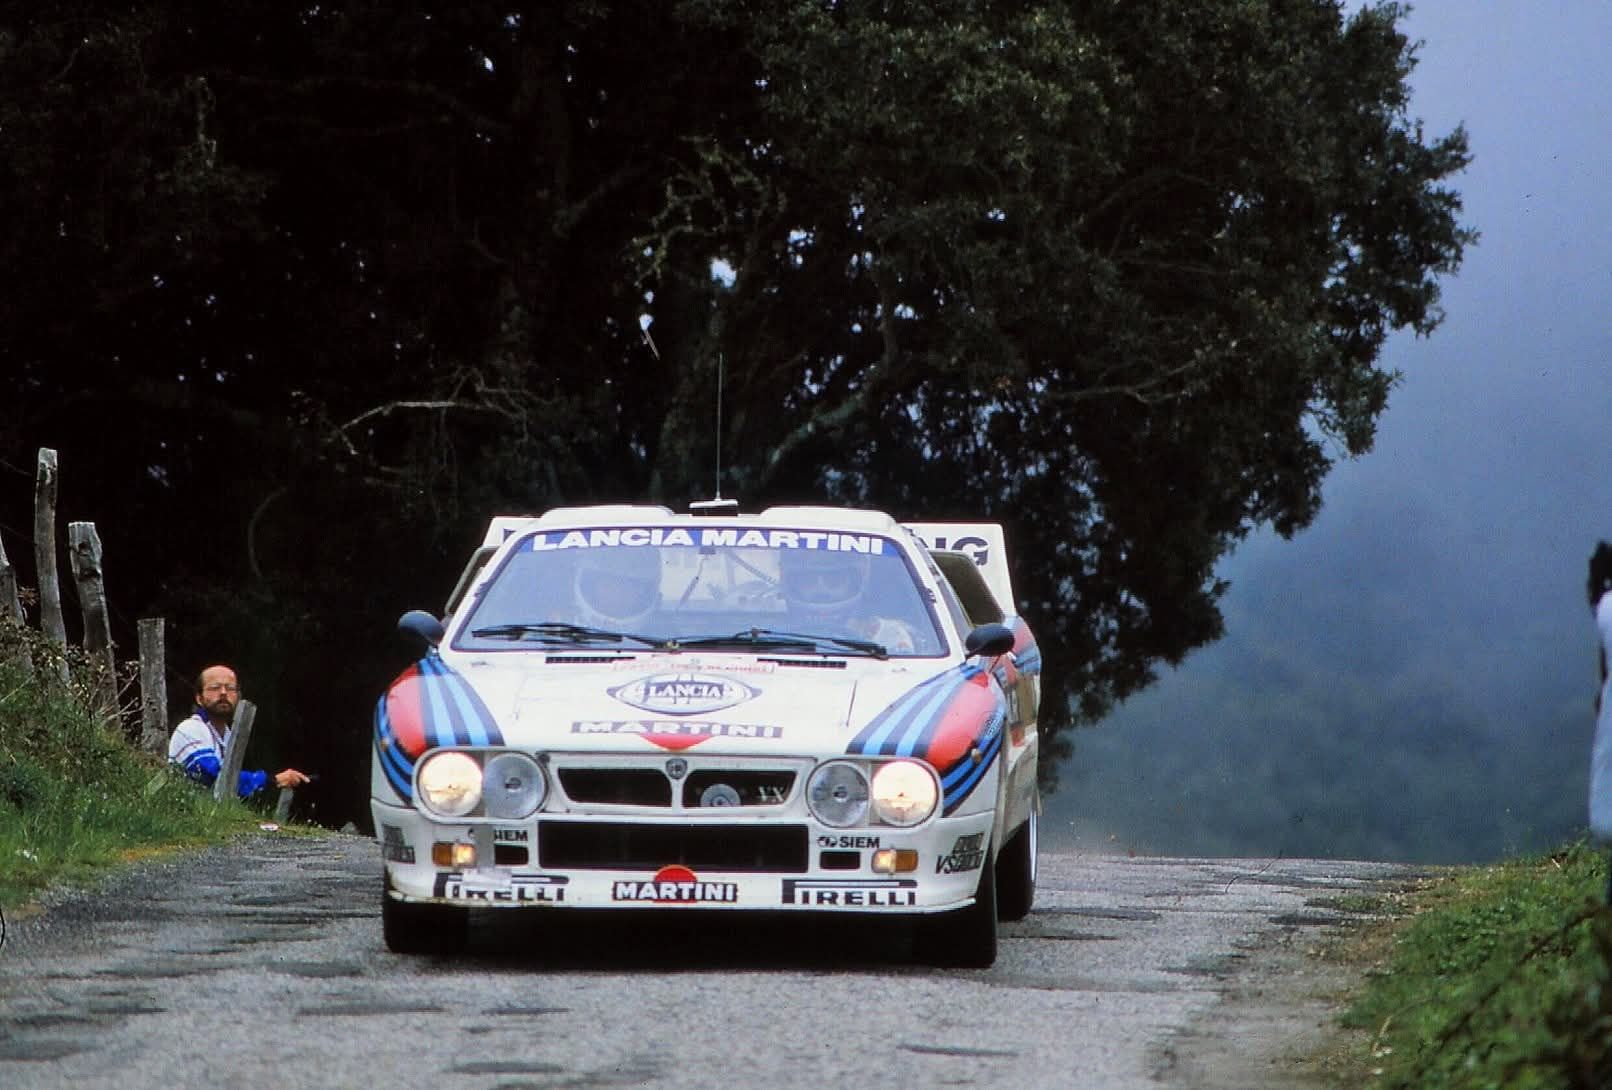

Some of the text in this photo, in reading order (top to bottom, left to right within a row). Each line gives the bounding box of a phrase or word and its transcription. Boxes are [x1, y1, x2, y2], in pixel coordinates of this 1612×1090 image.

[533, 528, 883, 555] LANCIA MARTINI
[650, 684, 721, 697] LANCIA
[579, 721, 775, 738] MARTINI
[839, 836, 880, 848] SIEM
[615, 882, 736, 900] MARTINI
[782, 879, 918, 905] PIRELLI
